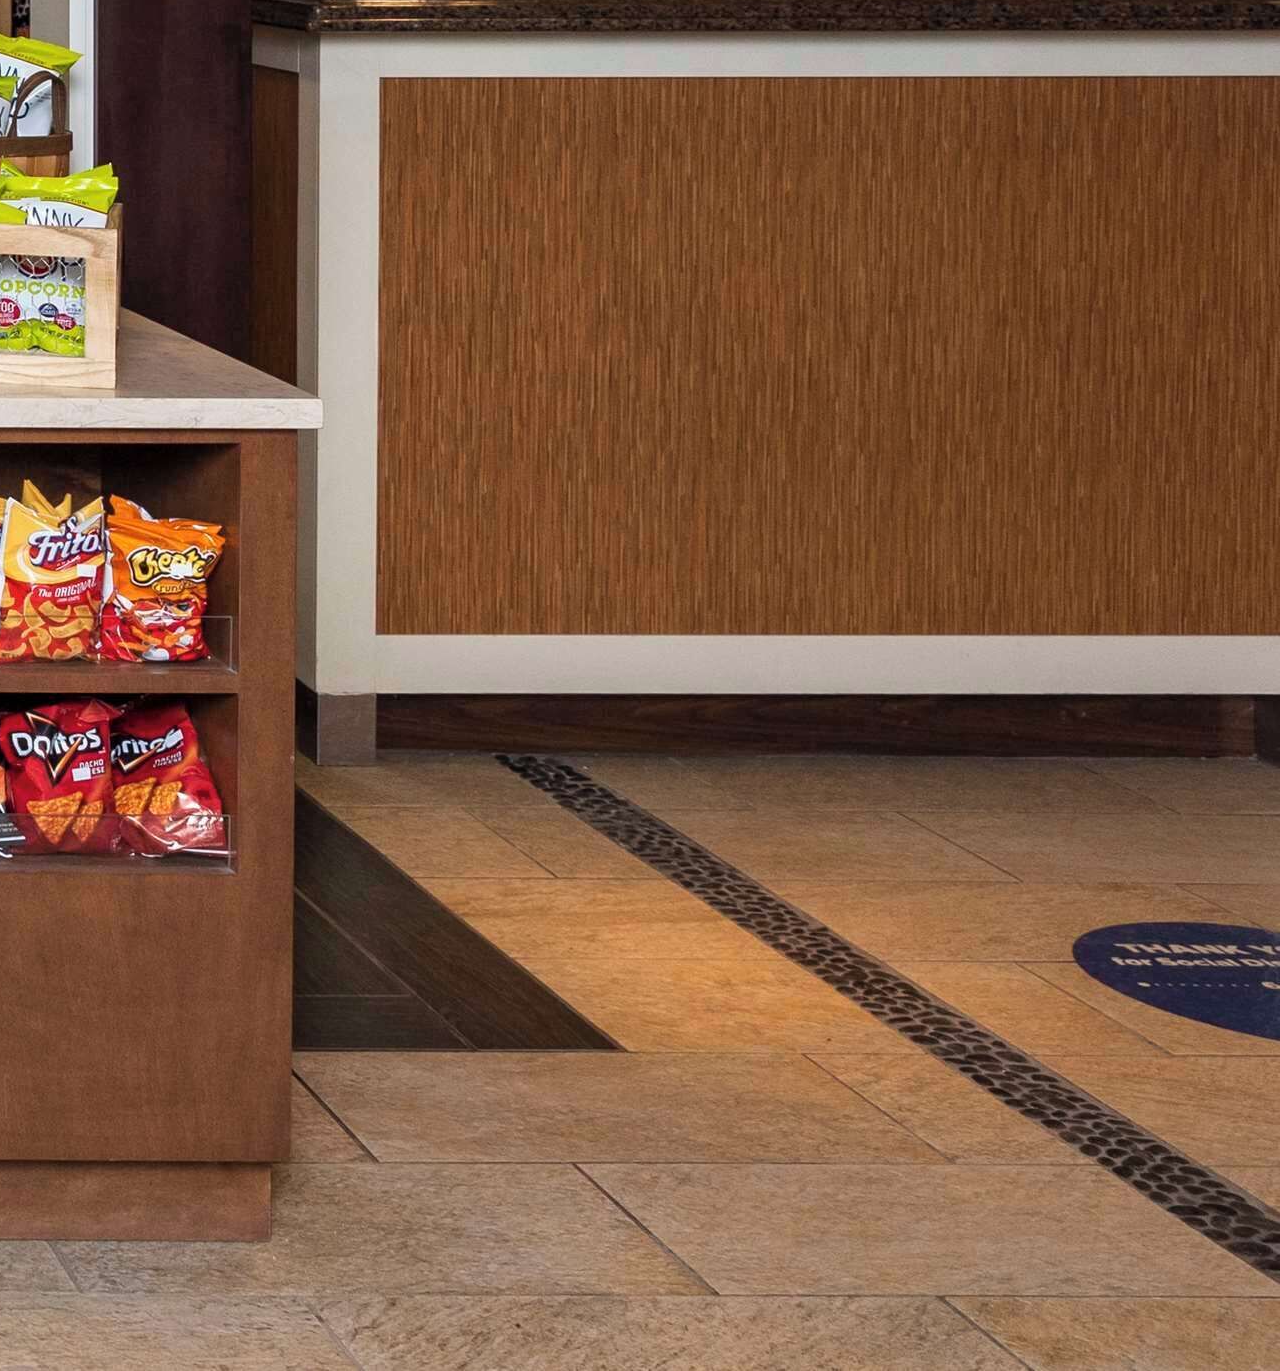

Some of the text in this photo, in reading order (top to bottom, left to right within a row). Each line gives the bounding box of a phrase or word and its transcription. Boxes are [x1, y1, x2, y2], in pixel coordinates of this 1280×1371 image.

[29, 529, 102, 565] Frito
[11, 728, 102, 760] Doritos
[79, 759, 104, 769] NACHO
[1113, 943, 1252, 955] THANK
[1110, 956, 1240, 967] for Social
